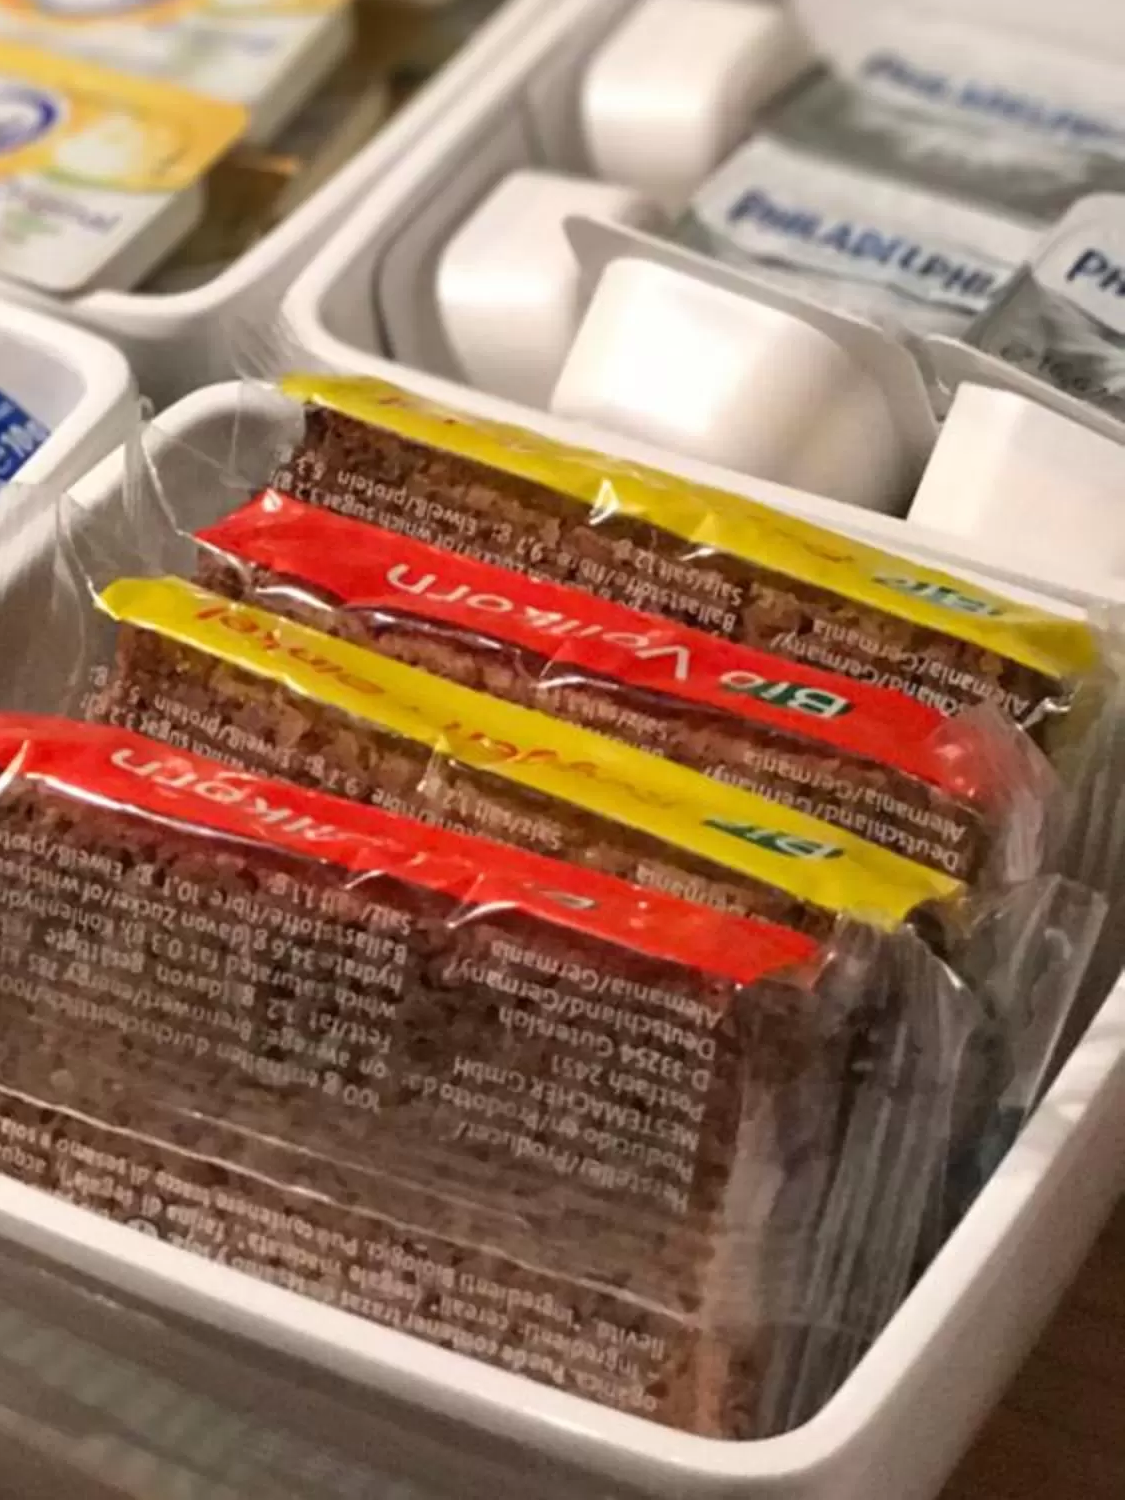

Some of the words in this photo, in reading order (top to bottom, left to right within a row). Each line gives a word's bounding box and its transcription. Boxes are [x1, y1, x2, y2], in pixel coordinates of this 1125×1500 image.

[725, 188, 995, 297] PHILADELPHI
[386, 562, 690, 681] Vollkorn
[811, 614, 1030, 717] Alemania/Germania
[720, 666, 848, 720] Bio
[739, 744, 965, 845] Alemania/Germania
[19, 861, 78, 900] which
[150, 929, 183, 962] 0,3
[188, 942, 219, 974] fat
[270, 933, 315, 972] 34,6
[334, 986, 395, 1025] which
[490, 936, 722, 1034] Alemania/Germania
[308, 1009, 390, 1057] Fett/fat
[321, 1067, 341, 1099] g
[451, 1050, 525, 1098] GmbH
[549, 1049, 602, 1088] 2451
[620, 1038, 710, 1093] D-33254
[342, 1079, 379, 1115] 100
[529, 1072, 699, 1154] MESTEMACHER
[608, 1067, 704, 1124] Postfach
